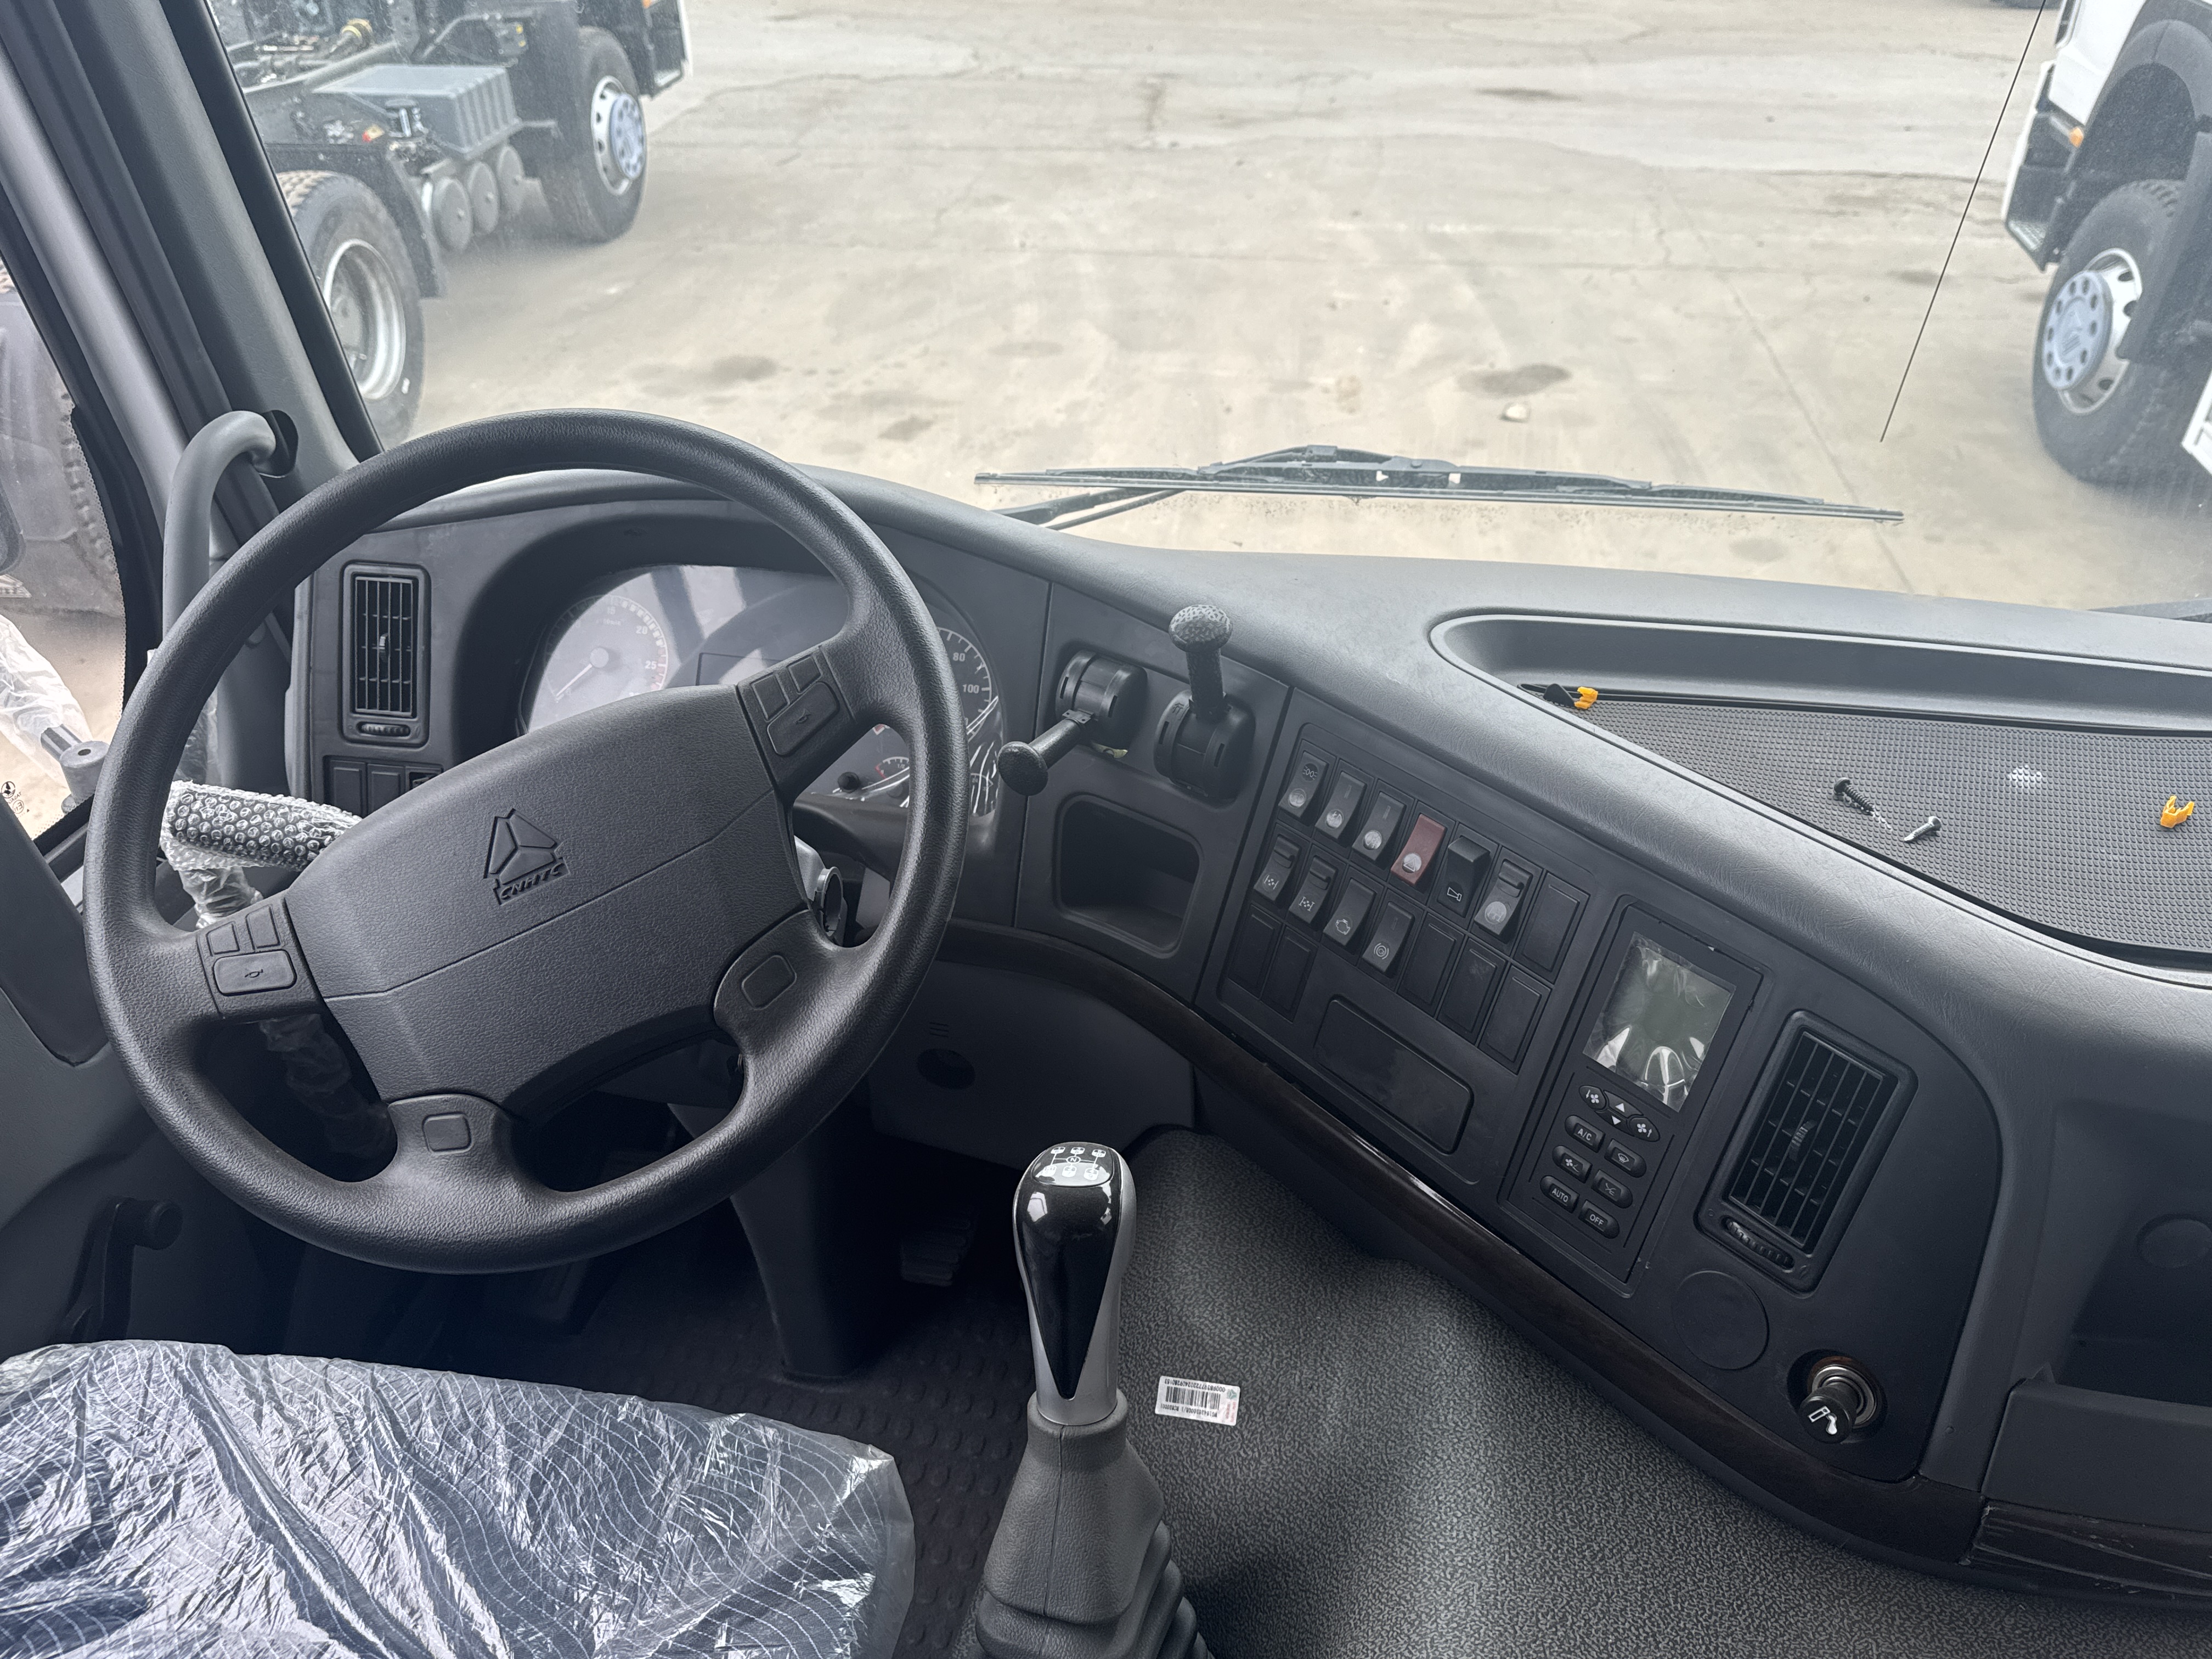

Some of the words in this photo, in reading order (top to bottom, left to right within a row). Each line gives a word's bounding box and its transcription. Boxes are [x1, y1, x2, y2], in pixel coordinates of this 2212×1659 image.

[636, 625, 648, 635] 20
[952, 652, 966, 662] 80
[645, 661, 657, 670] 25
[962, 684, 980, 694] 100
[1577, 1128, 1592, 1141] A/C
[1551, 1187, 1569, 1203] AUTO
[1589, 1214, 1604, 1226] OFF
